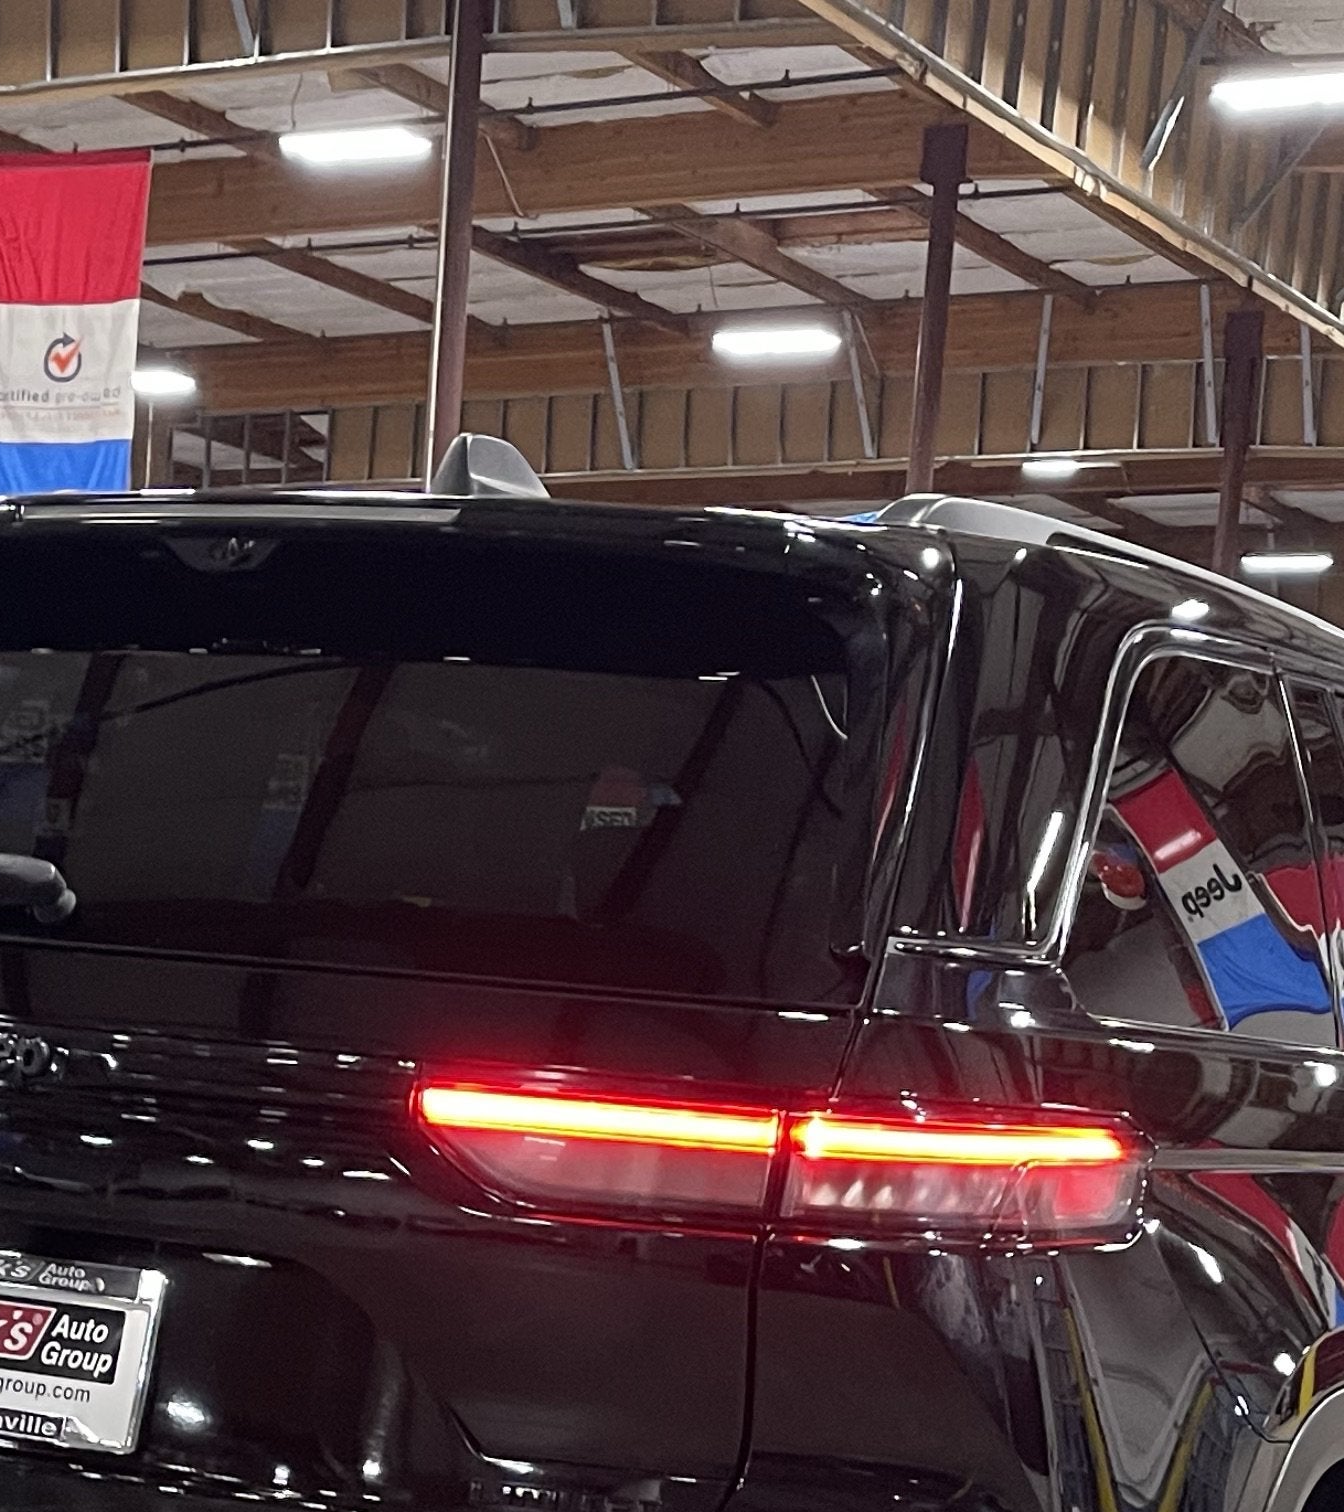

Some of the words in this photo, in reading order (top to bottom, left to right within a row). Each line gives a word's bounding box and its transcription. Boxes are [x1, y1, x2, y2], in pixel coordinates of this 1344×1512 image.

[38, 1272, 94, 1292] Group
[46, 1262, 87, 1279] Auto
[51, 1313, 110, 1344] Auto
[40, 1341, 114, 1378] Group
